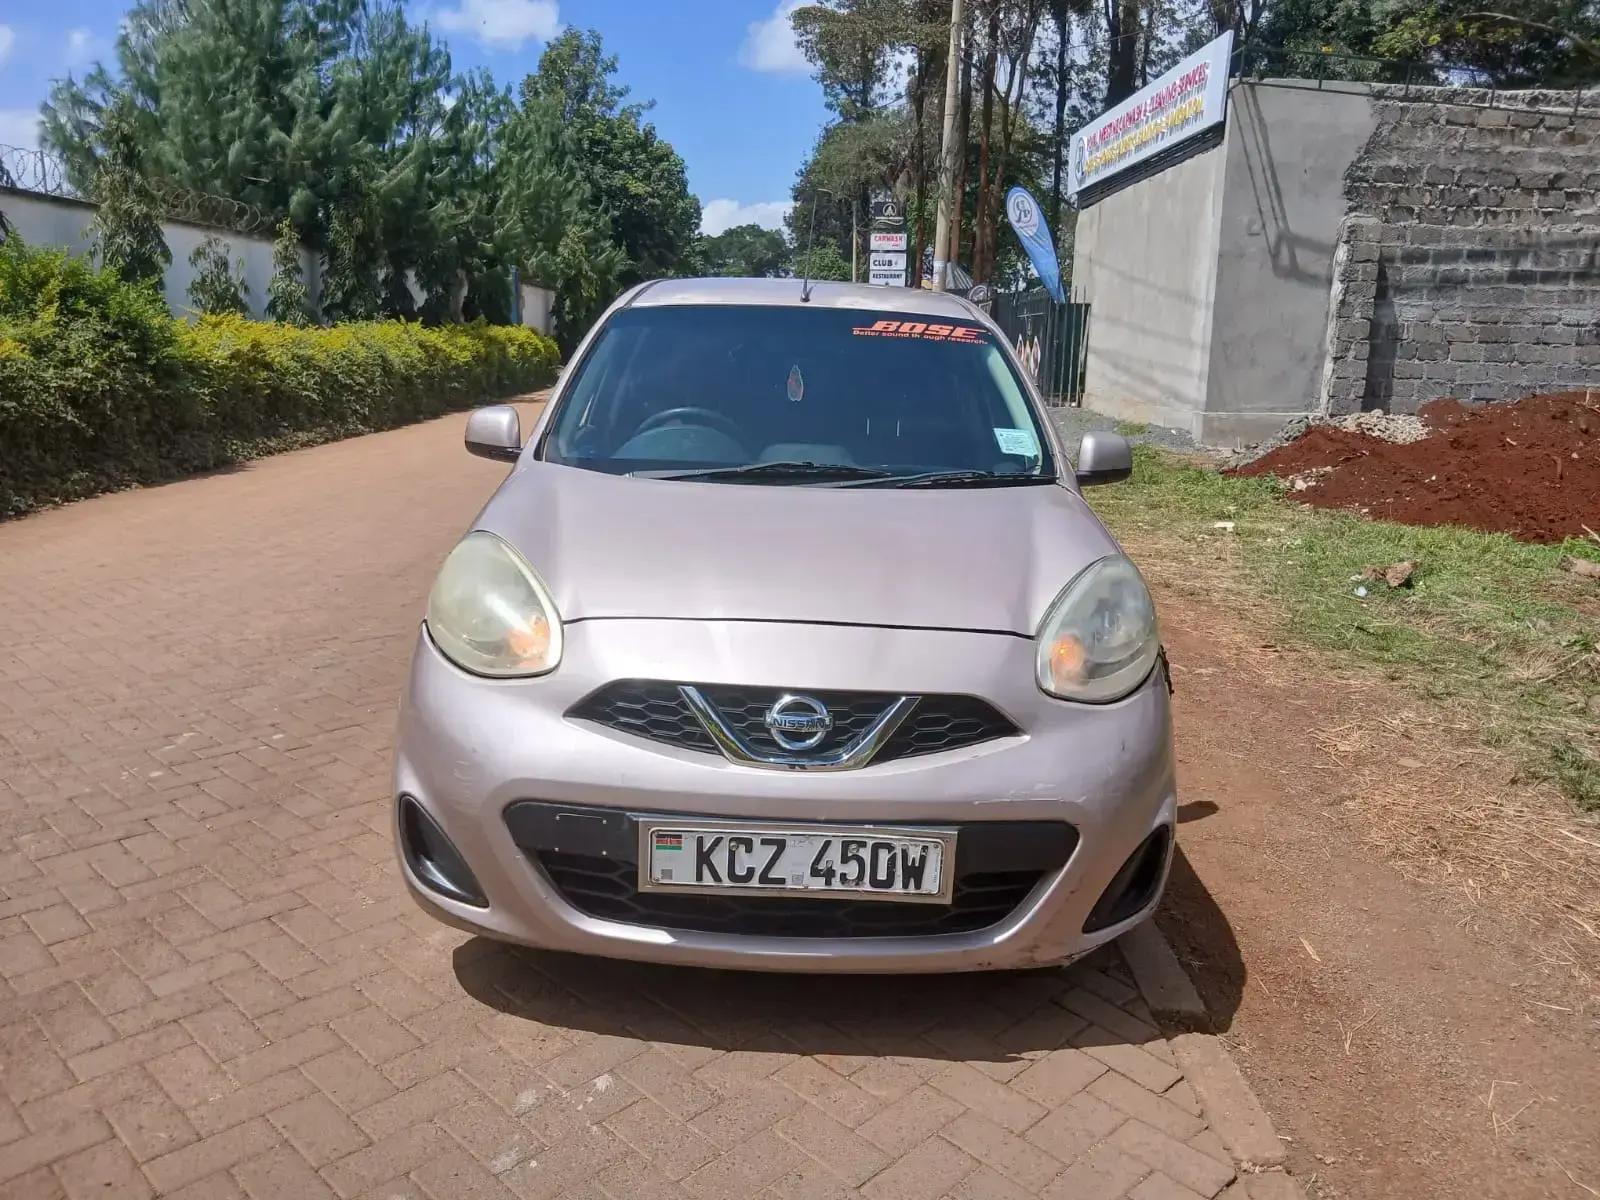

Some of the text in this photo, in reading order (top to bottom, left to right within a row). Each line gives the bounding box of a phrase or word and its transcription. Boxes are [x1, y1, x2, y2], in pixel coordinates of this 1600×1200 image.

[1149, 80, 1178, 113] CLEANING
[1177, 62, 1206, 93] SERVICES
[852, 320, 987, 339] BOSE
[773, 717, 827, 729] NISSAN
[695, 835, 787, 885] KCZ
[810, 839, 928, 890] 450W
